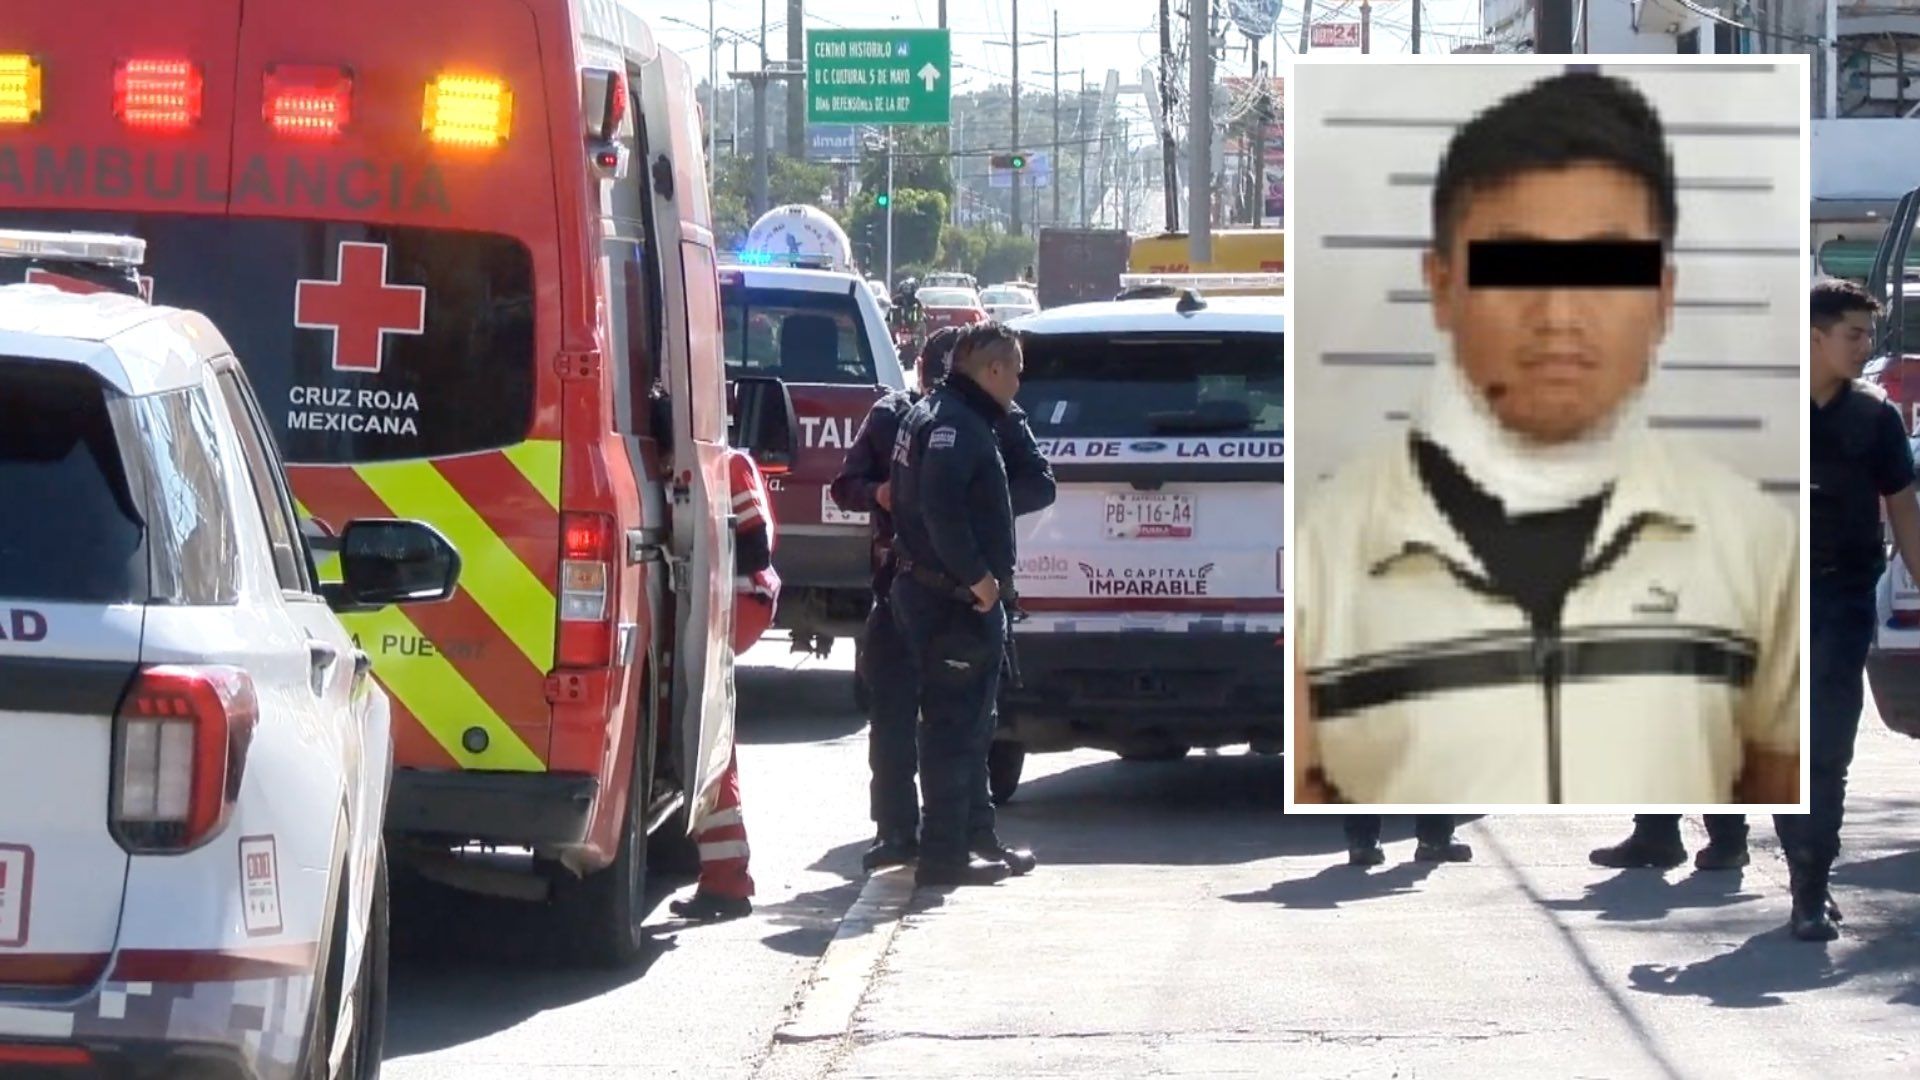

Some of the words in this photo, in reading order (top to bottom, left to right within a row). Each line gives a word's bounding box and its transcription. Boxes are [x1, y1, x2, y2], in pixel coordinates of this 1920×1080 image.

[815, 42, 846, 57] CENTRO
[831, 69, 866, 84] CULTURAL
[878, 69, 887, 84] DE
[890, 69, 910, 84] MAYO
[875, 97, 883, 111] DE
[886, 97, 895, 111] LA
[0, 146, 452, 214] AMBULANCIA
[289, 386, 352, 406] CRUZ
[358, 389, 420, 411] ROJA
[287, 411, 418, 436] MEXICANA
[1085, 441, 1122, 457] DE
[1176, 442, 1210, 457] LA
[1106, 503, 1191, 523] PB-116-A4
[1096, 568, 1115, 578] LA
[1123, 567, 1197, 578] CAPITAL
[1089, 580, 1207, 595] IMPARABLE
